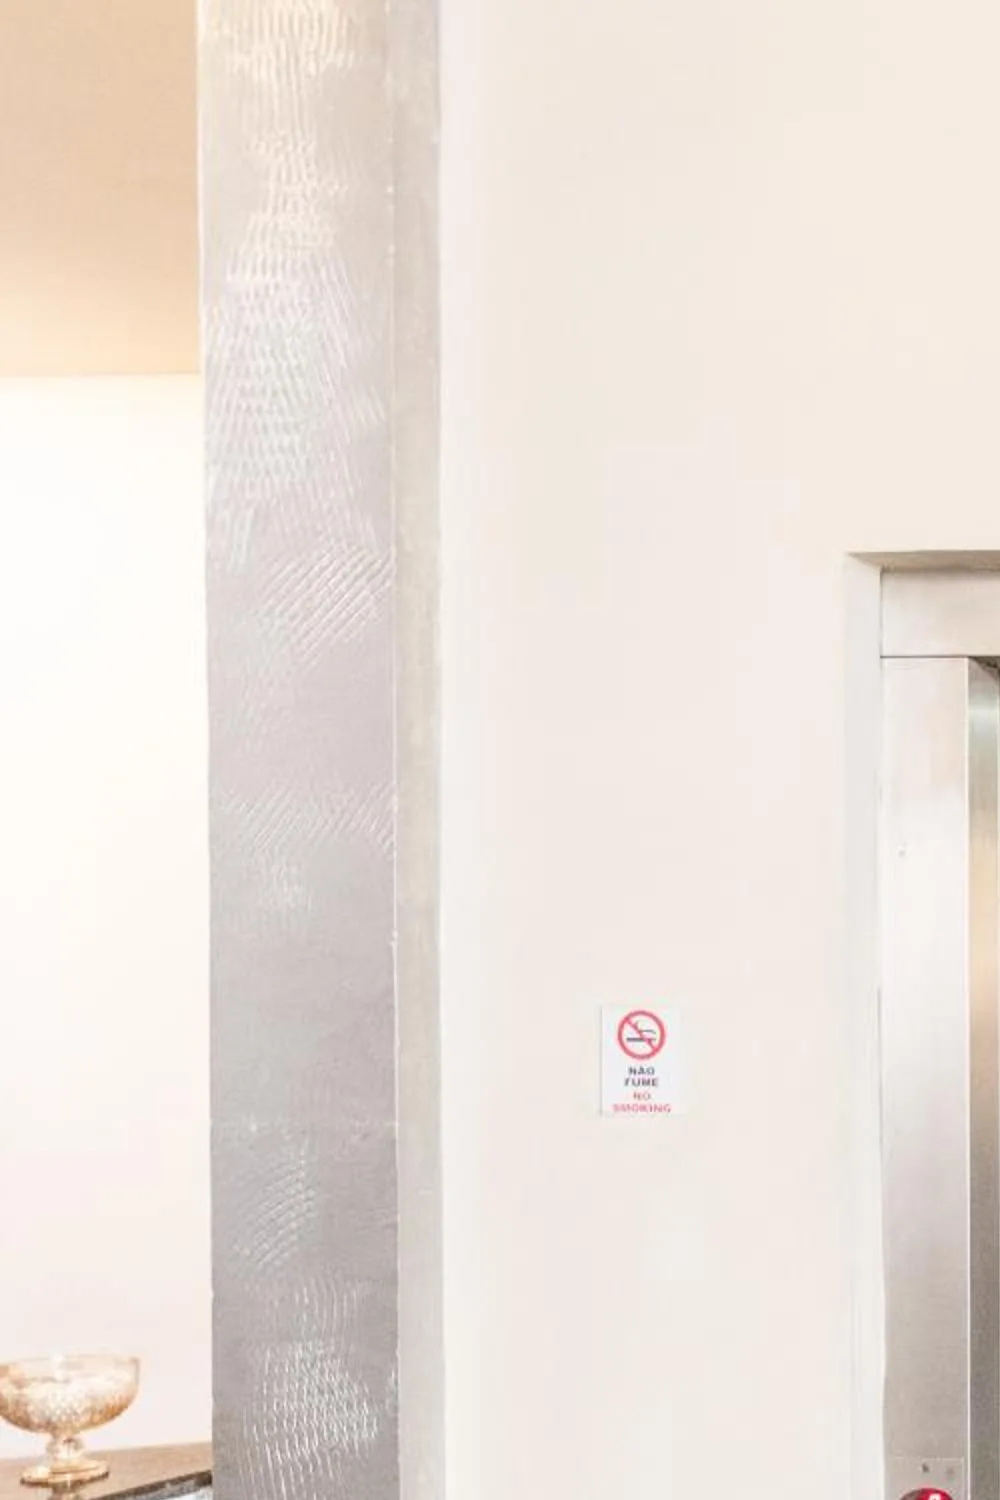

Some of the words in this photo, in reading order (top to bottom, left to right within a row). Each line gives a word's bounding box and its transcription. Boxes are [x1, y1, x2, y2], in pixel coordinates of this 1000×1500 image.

[628, 1064, 655, 1076] NÃO
[624, 1077, 658, 1087] FUME
[633, 1091, 651, 1101] NO
[612, 1102, 672, 1113] SMOKING
